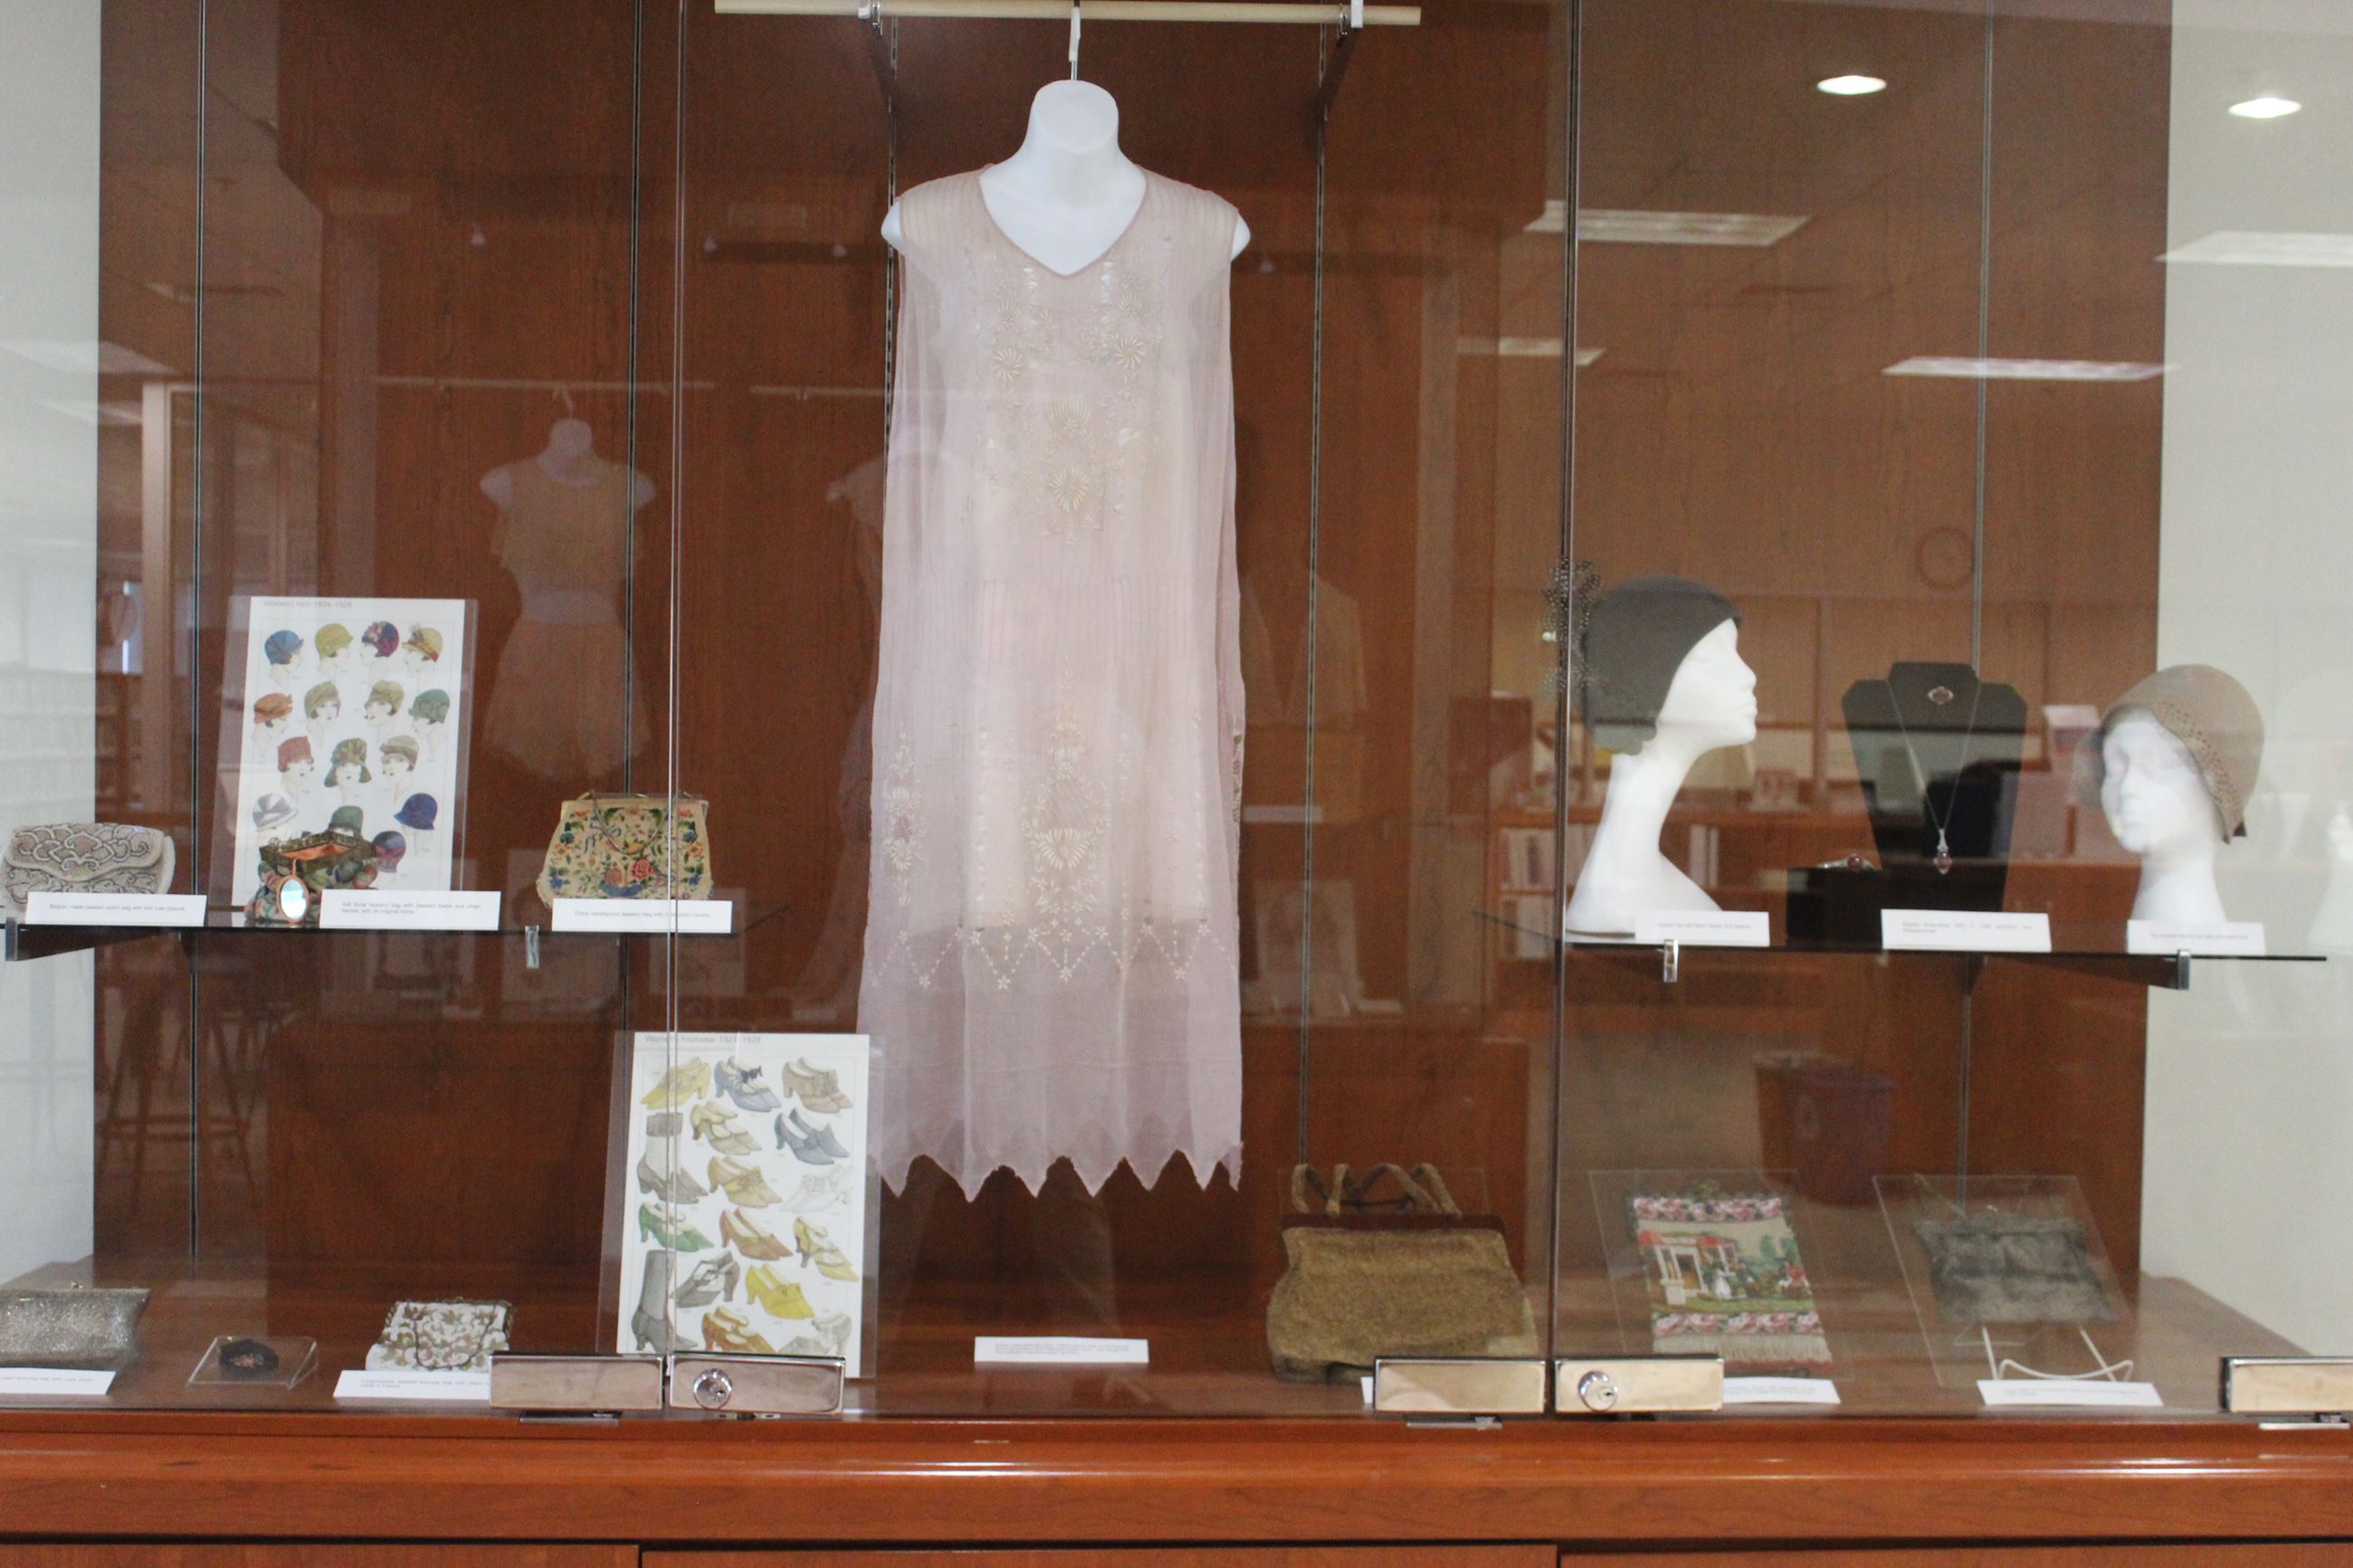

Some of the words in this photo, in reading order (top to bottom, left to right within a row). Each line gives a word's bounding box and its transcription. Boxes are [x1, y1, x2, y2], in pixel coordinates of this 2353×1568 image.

[262, 600, 294, 608] Women's
[295, 600, 312, 608] Hats
[681, 1034, 716, 1043] Footwear
